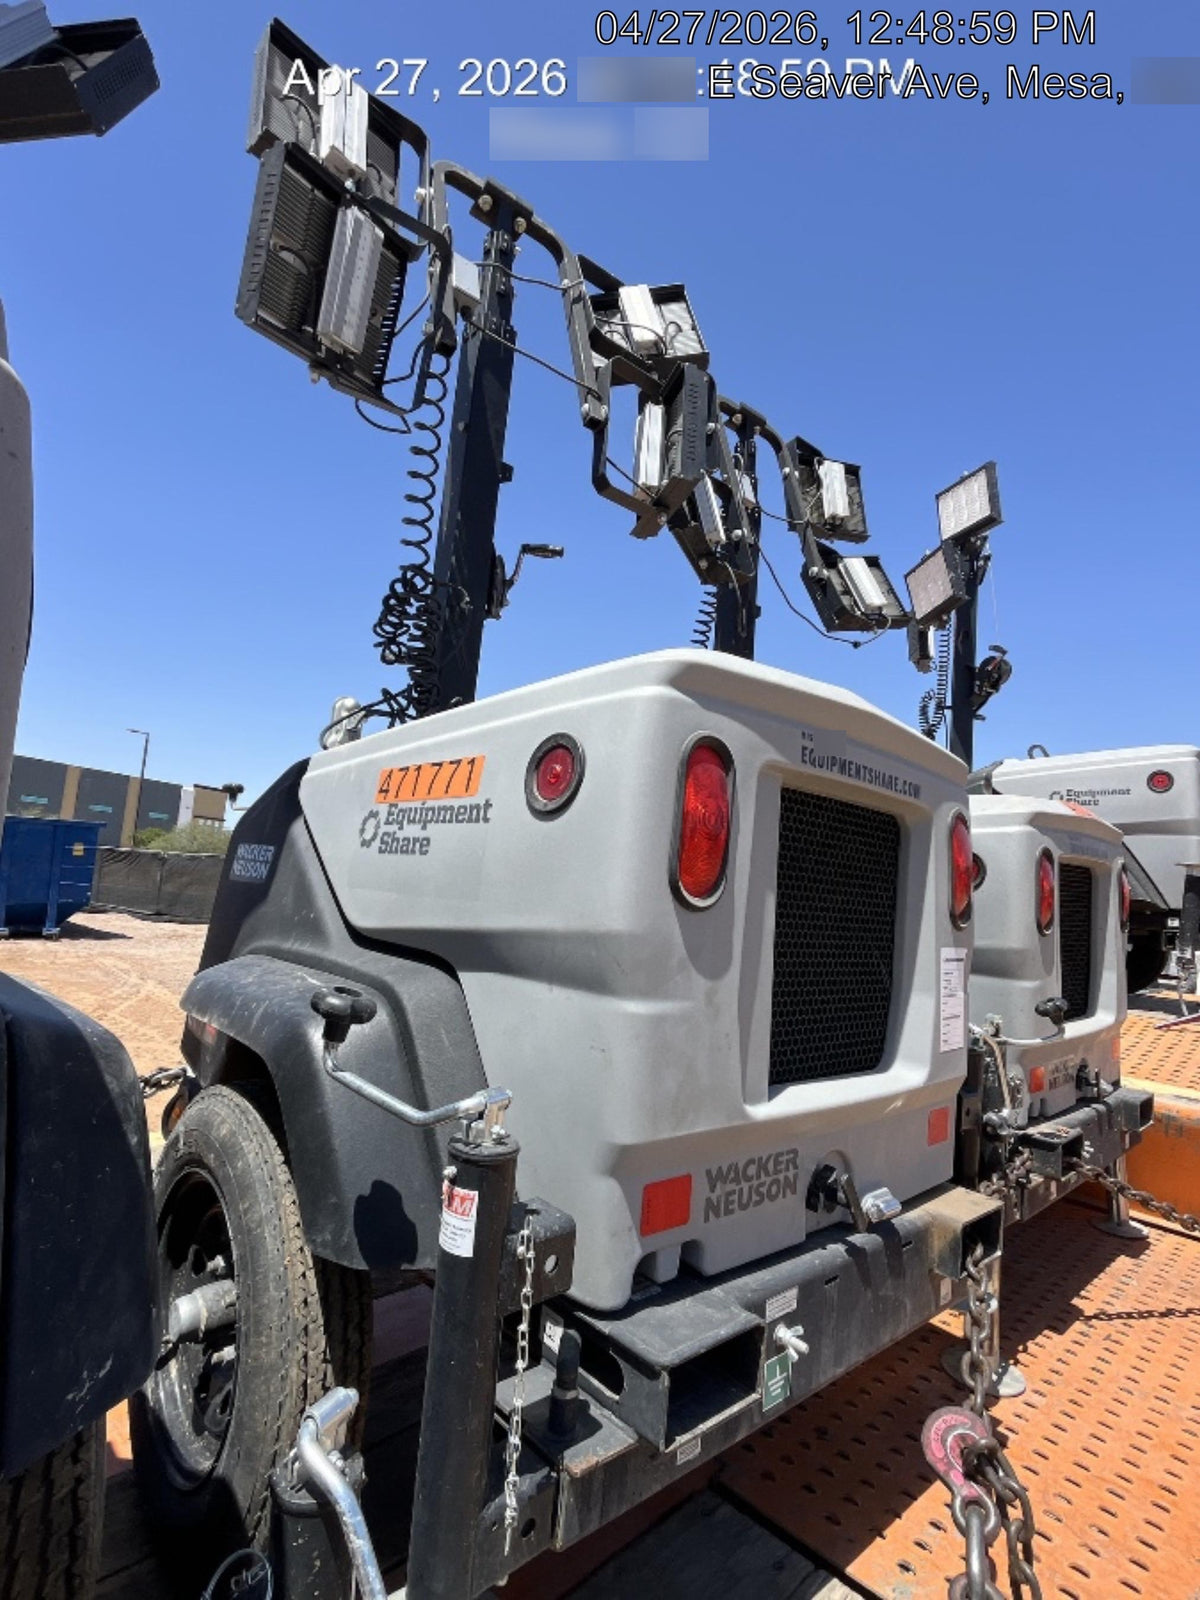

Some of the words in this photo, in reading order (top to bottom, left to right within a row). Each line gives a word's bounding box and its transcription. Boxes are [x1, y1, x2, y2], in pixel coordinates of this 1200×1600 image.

[378, 757, 476, 800] 471771
[384, 798, 493, 830] Equipment
[378, 831, 431, 856] Share
[705, 1147, 799, 1194] WACKER
[704, 1171, 799, 1224] NEUSON
